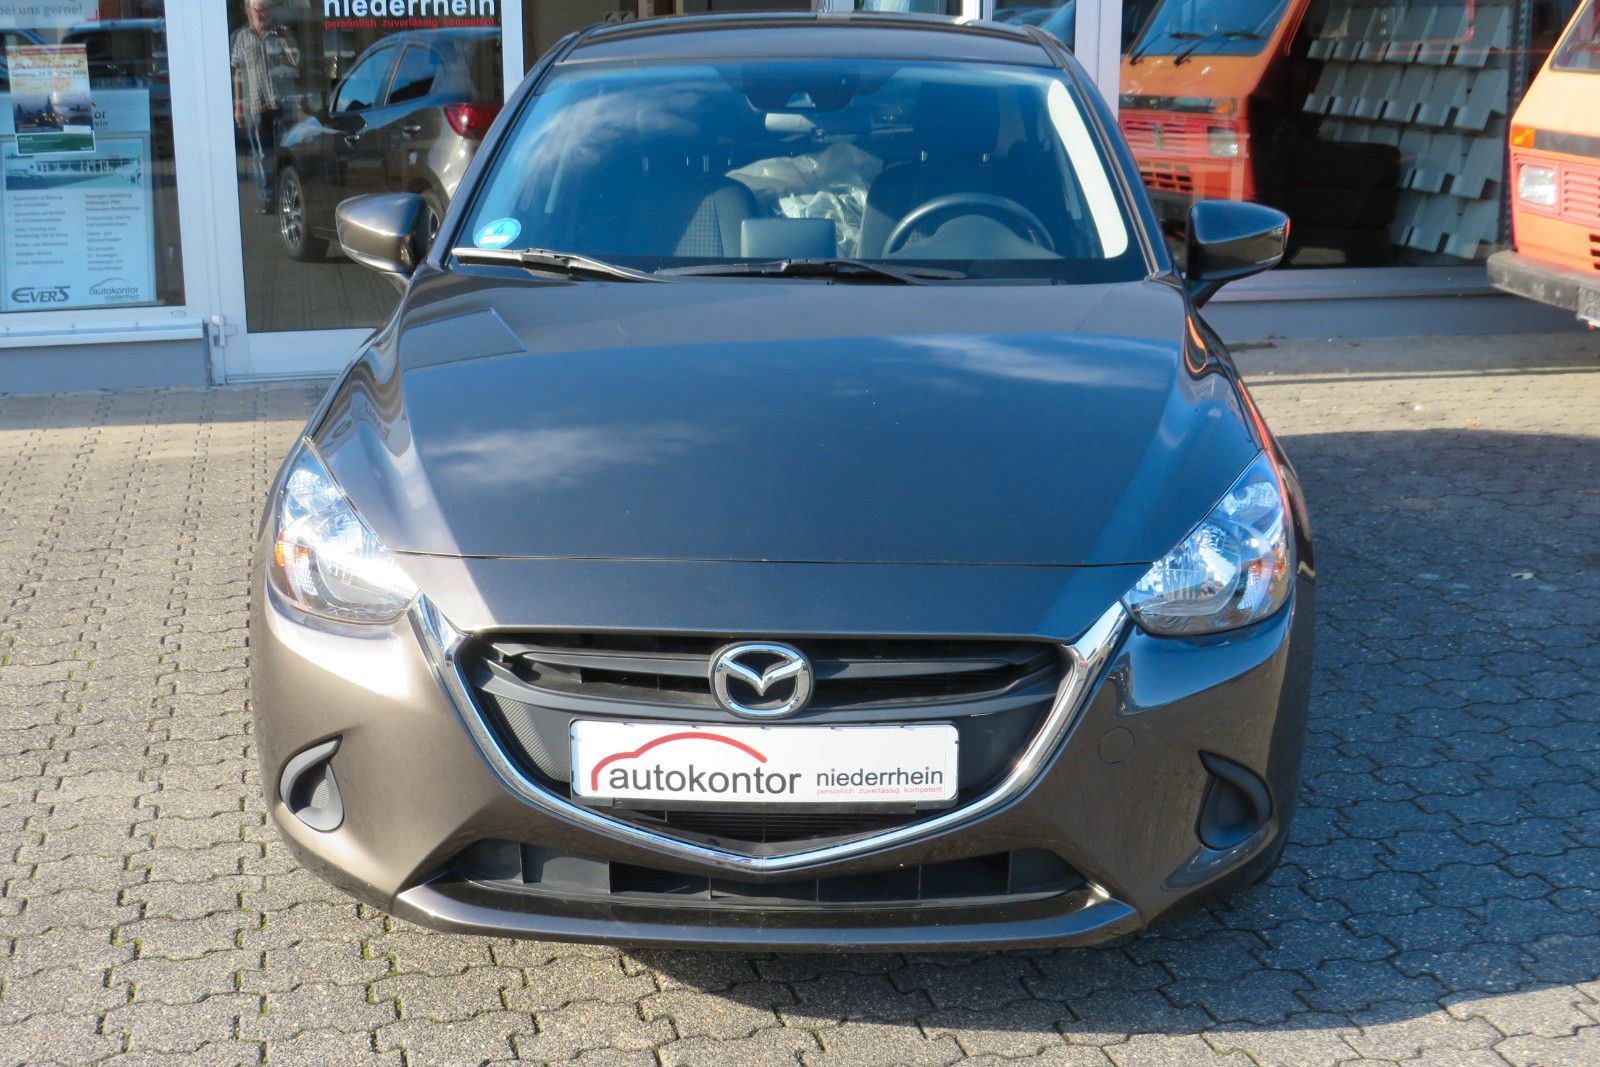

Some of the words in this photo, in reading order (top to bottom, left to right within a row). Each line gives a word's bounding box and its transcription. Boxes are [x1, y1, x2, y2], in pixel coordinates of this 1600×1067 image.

[17, 6, 40, 15] uns
[323, 18, 377, 30] persönlich
[382, 17, 438, 29] zuverlässig
[92, 286, 139, 296] autokontor
[609, 764, 802, 794] autokontor
[816, 766, 943, 786] niederrhein
[816, 787, 855, 795] persönlich
[858, 786, 900, 794] zuverlässig
[903, 785, 943, 793] kompetent
